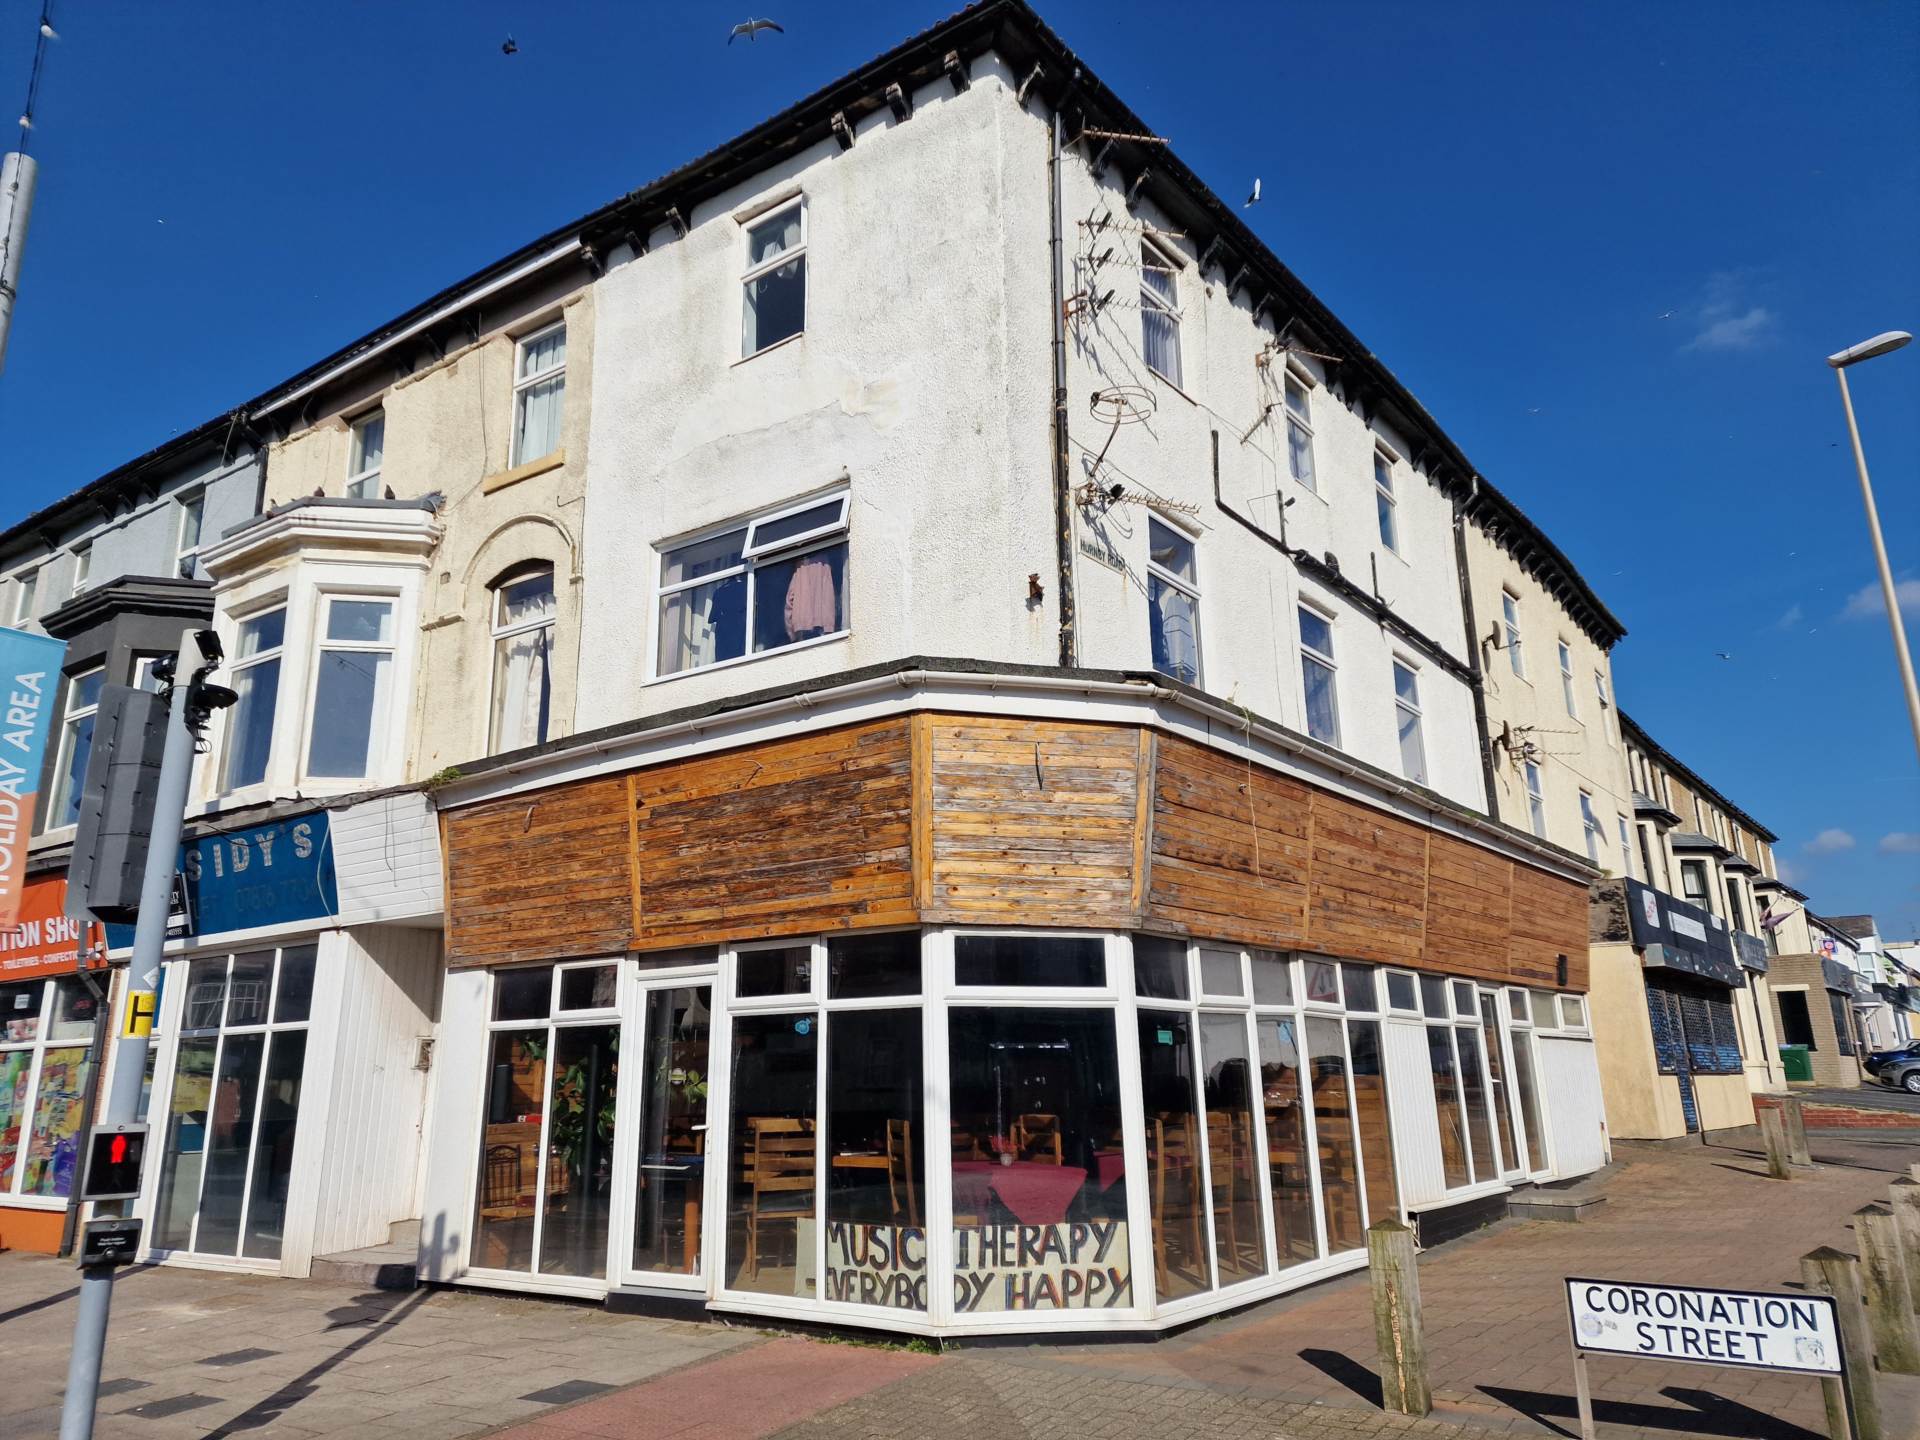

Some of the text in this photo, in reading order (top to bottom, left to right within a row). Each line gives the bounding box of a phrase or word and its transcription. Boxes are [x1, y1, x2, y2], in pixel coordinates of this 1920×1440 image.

[3, 671, 46, 752] AREA
[827, 1223, 1118, 1271] MUSIC THERAPY
[1005, 1267, 1131, 1310] HAPPY
[1586, 1286, 1818, 1332] CORONATION
[1637, 1321, 1768, 1361] STREET
